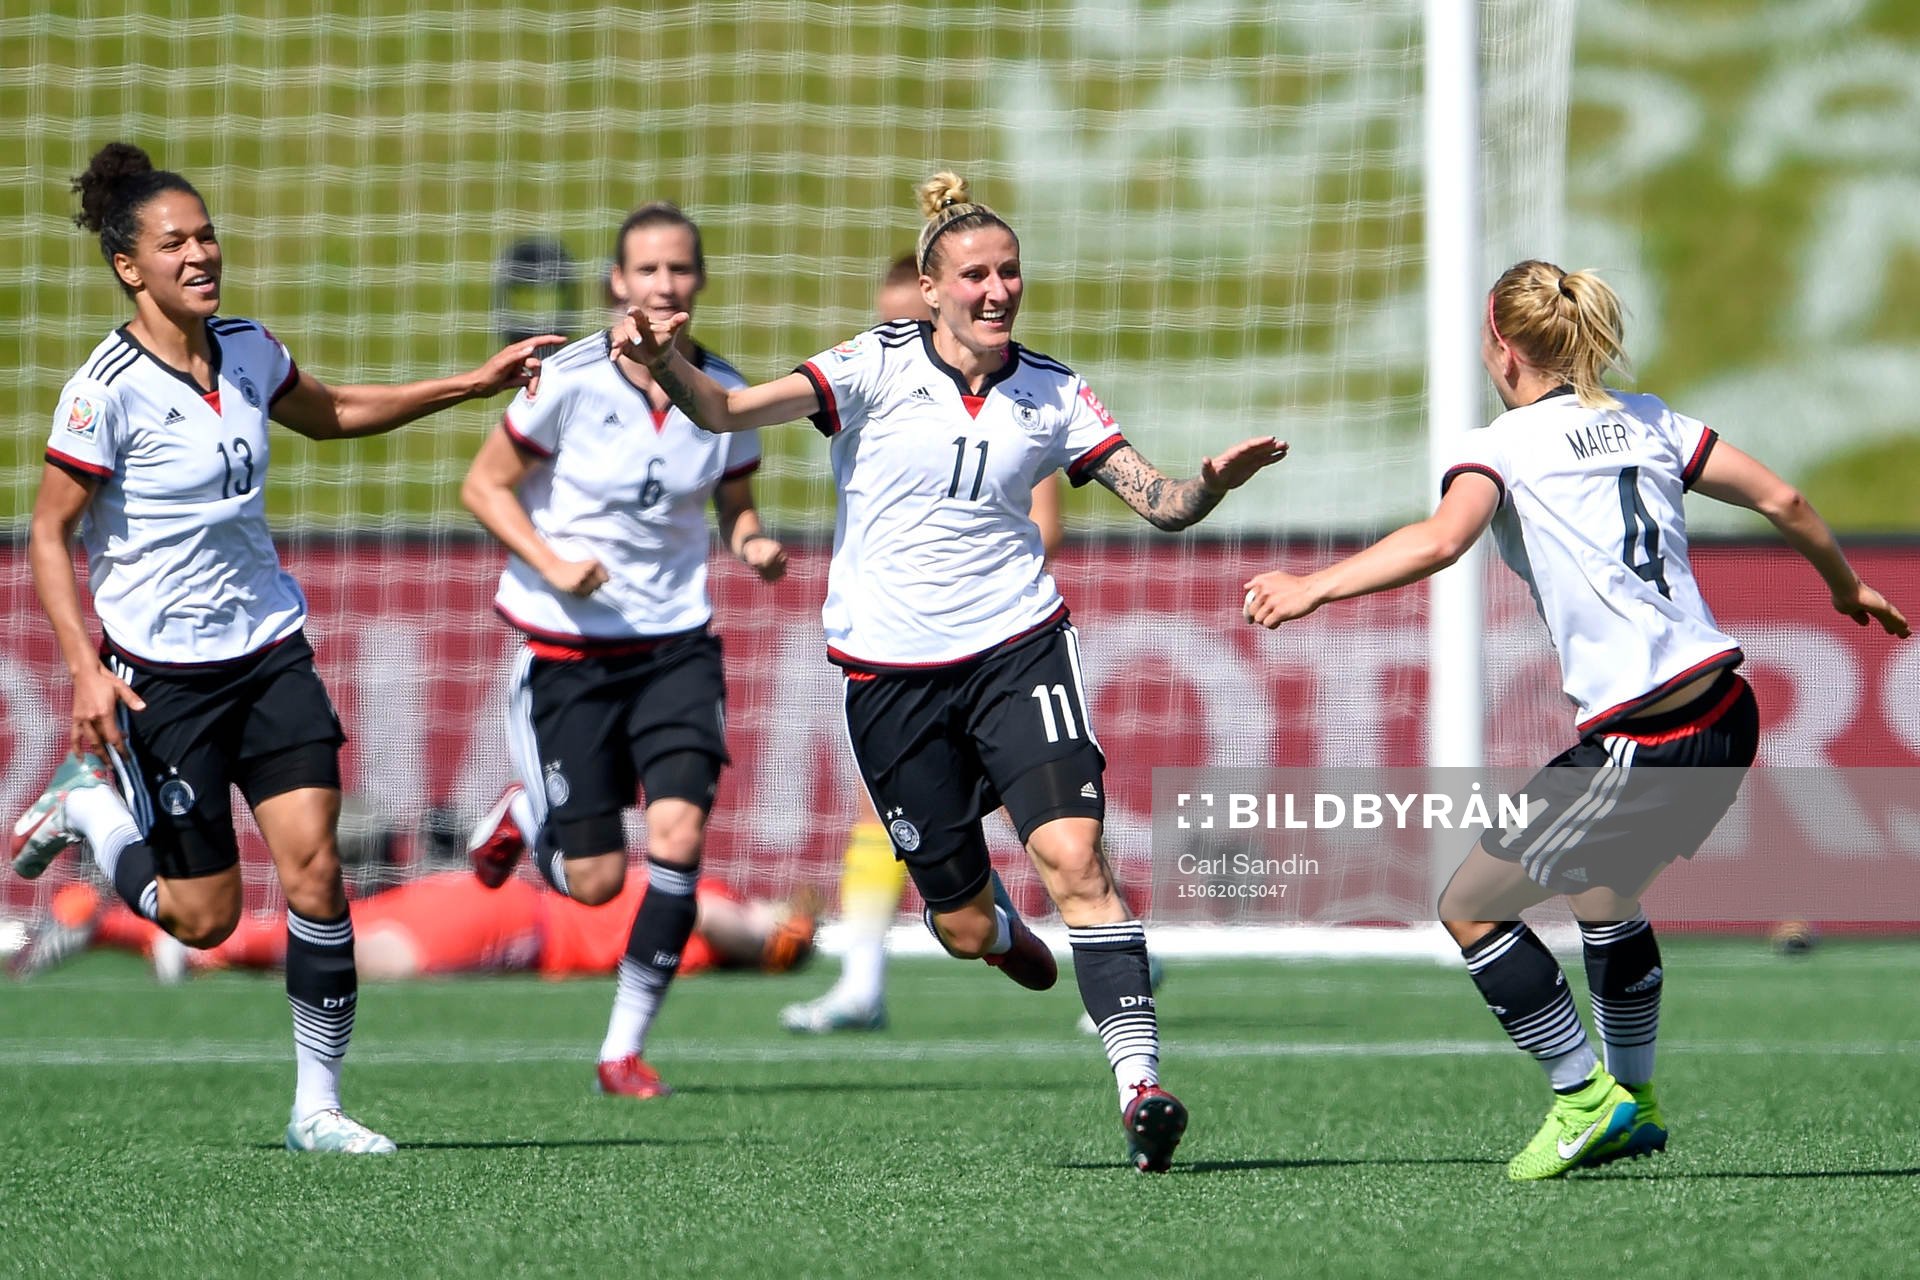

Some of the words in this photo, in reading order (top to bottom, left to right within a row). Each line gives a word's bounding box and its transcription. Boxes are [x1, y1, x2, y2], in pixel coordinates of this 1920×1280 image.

[216, 436, 254, 500] 13
[948, 436, 989, 502] 11
[1565, 423, 1632, 461] MAIER
[640, 457, 667, 508] 6
[1618, 465, 1673, 602] 4
[1031, 684, 1079, 743] 11
